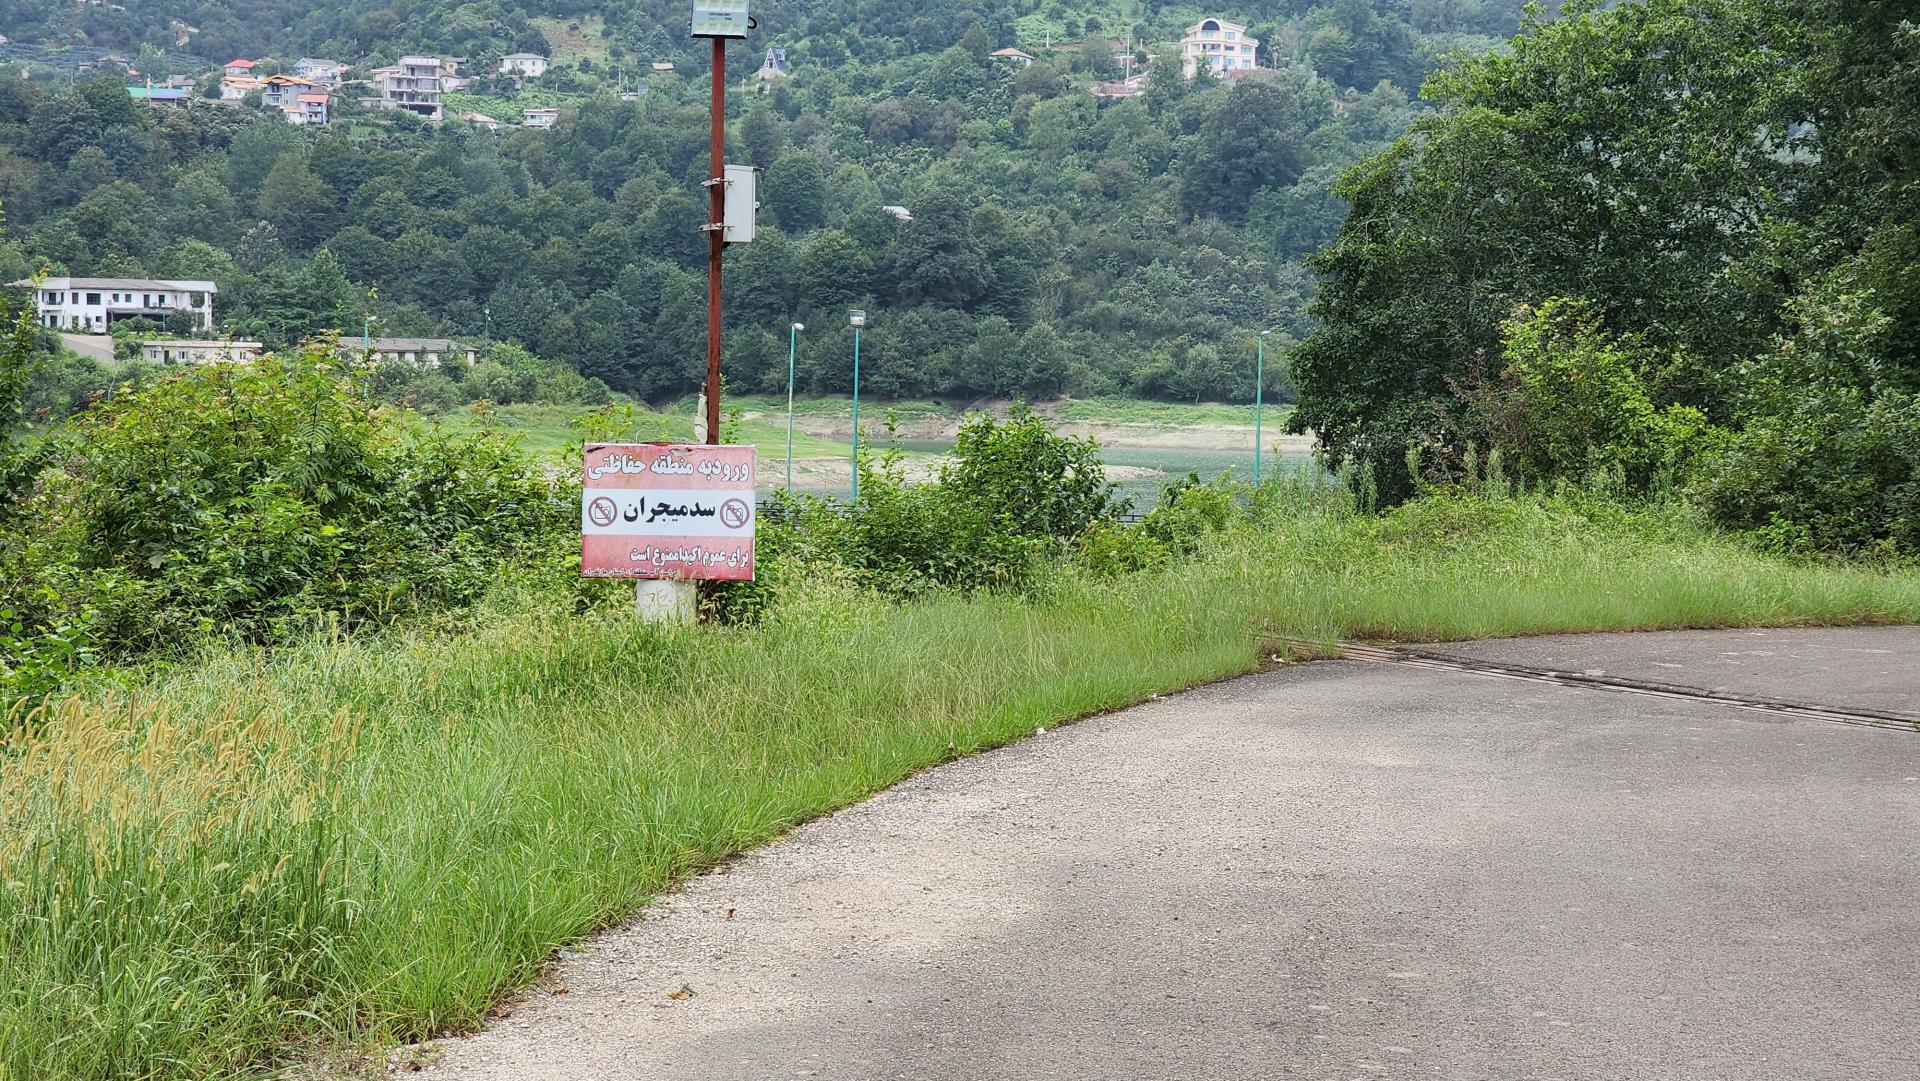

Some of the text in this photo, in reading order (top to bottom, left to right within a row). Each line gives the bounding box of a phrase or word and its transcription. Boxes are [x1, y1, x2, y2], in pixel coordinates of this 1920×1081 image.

[586, 453, 647, 481] حفاظتی
[650, 454, 694, 475] منطقه
[629, 544, 651, 561] است
[702, 550, 727, 567] عموم
[727, 546, 750, 568] برای
